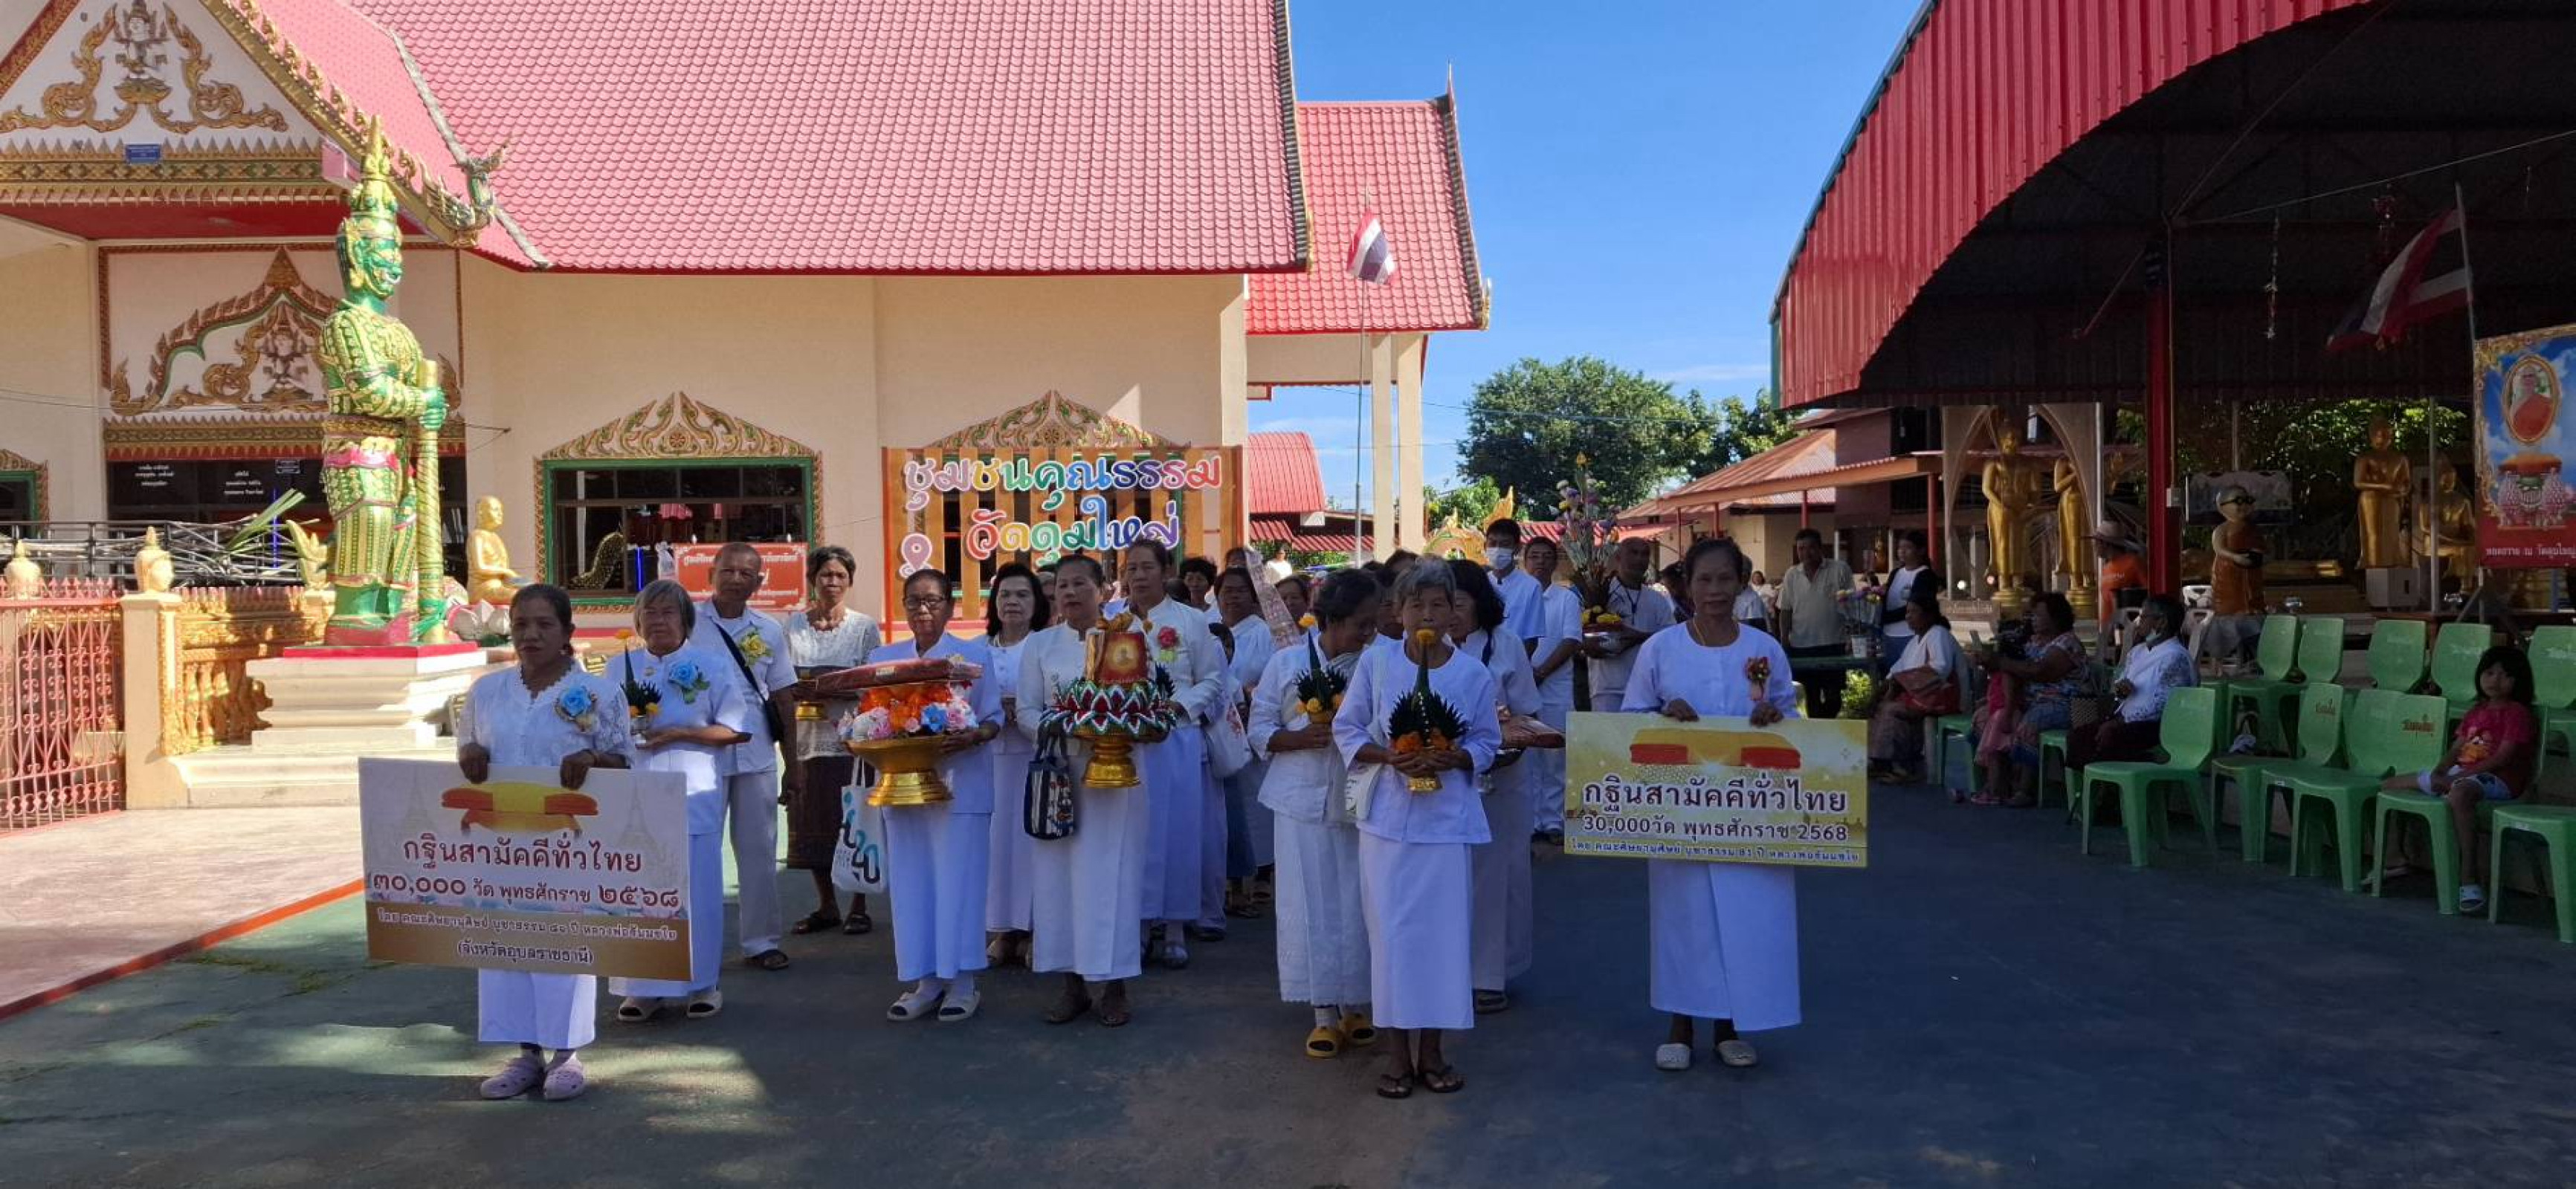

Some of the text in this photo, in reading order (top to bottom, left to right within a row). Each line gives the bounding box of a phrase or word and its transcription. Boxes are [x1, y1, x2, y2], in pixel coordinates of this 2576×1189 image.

[905, 456, 1222, 511] ชุมชนคุณธรรม
[966, 496, 1180, 567] วัดดุมใหญ่
[1584, 772, 1847, 813] กฐินสามัคคีทั่วไทย
[1584, 814, 1848, 842] 30,000วัด พุทธศักราช 2568
[402, 832, 642, 873] กฐินสามัคคีทั่วไทย
[372, 873, 680, 907] ๓๐,๐๐๐ วัด พุทธศักราช ๒๕๖๘
[457, 939, 595, 965] (จังหวัดอุบลราชธานี)
